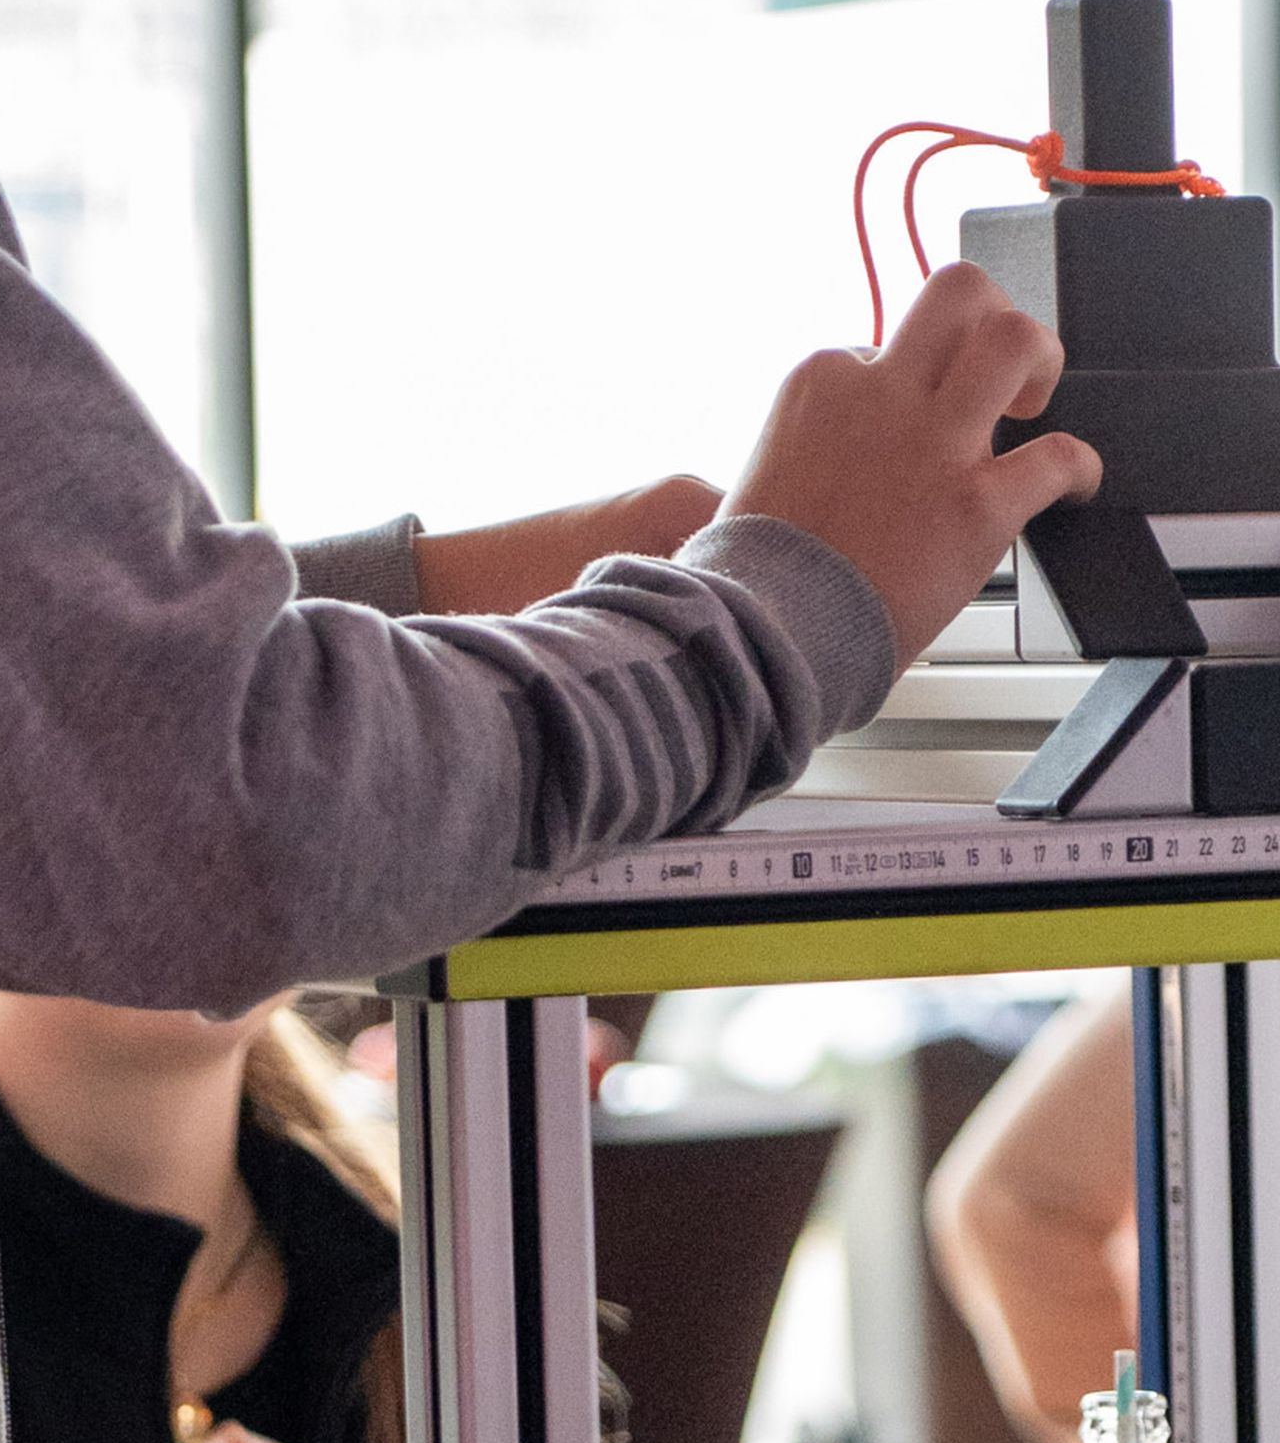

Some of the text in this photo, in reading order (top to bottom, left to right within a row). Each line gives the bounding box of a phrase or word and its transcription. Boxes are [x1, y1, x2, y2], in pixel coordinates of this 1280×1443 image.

[795, 854, 811, 876] 10
[831, 855, 842, 873] 11
[864, 853, 877, 871] 12
[899, 852, 911, 869] 13
[933, 851, 945, 867] 14
[967, 848, 979, 866] 15
[1001, 847, 1013, 865] 16
[1034, 845, 1045, 863] 17
[1067, 844, 1079, 861] 18
[1101, 842, 1112, 859] 19
[1129, 839, 1149, 859] 20
[1166, 839, 1178, 856] 21
[1199, 837, 1213, 855] 22
[1232, 836, 1245, 854] 23
[1265, 834, 1278, 852] 24
